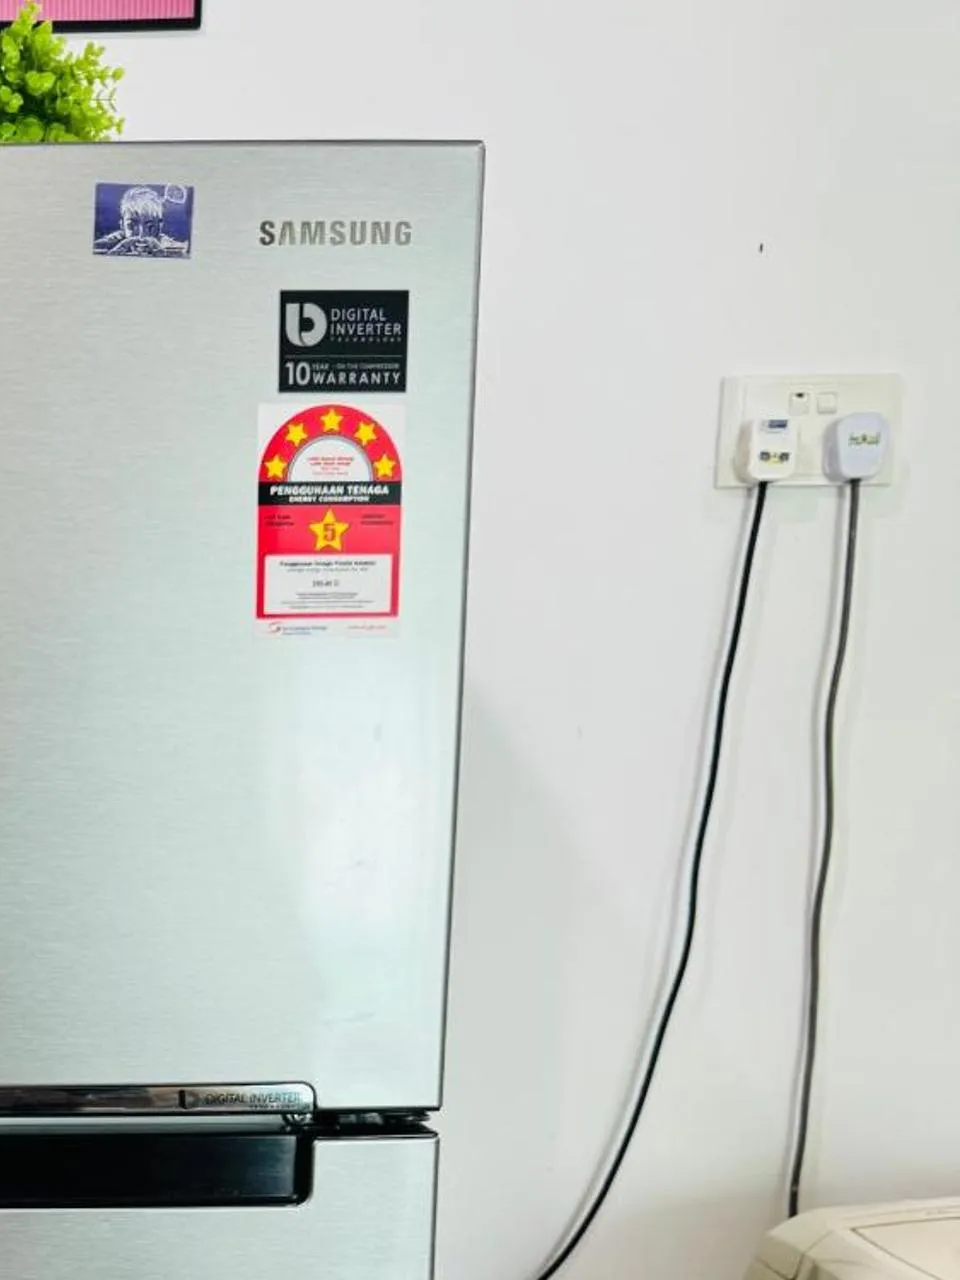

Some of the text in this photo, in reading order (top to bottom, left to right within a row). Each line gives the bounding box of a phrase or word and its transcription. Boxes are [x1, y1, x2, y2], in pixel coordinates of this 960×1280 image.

[259, 220, 413, 246] SAMSUNG
[331, 308, 386, 321] DIGITAL
[330, 322, 402, 335] INVERTER
[285, 362, 310, 385] 10
[312, 372, 400, 385] WARRANTY
[347, 485, 390, 495] TENAGA
[323, 523, 337, 541] 5
